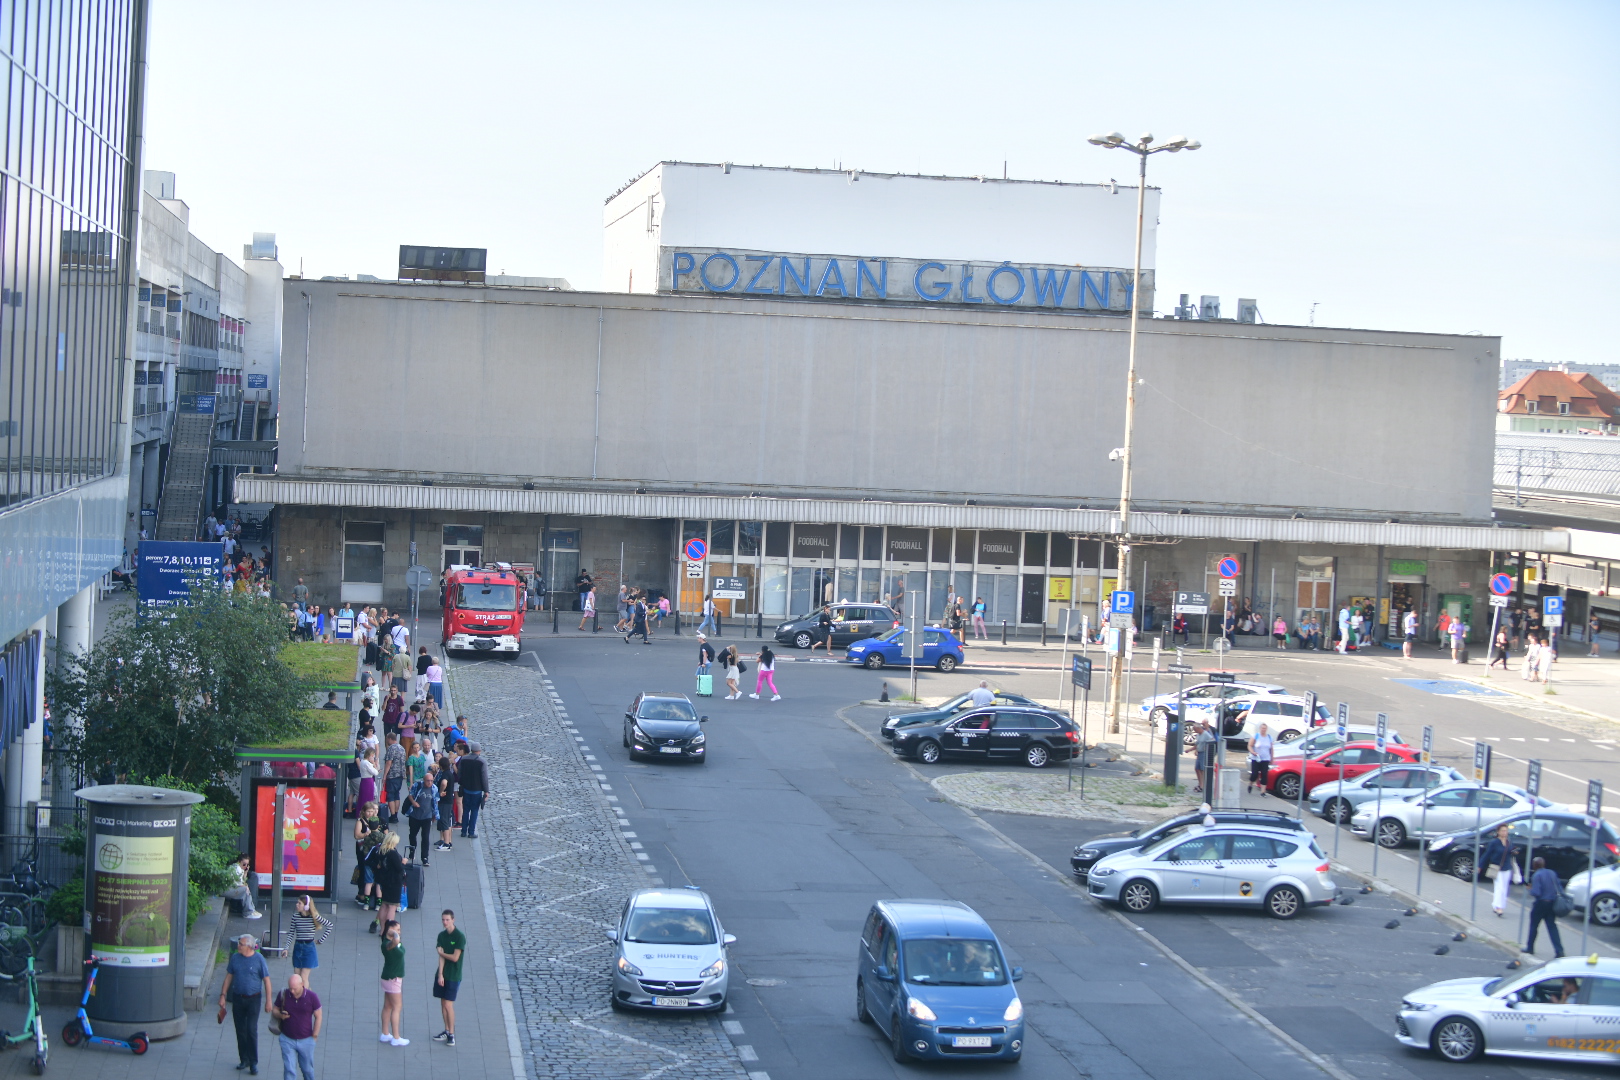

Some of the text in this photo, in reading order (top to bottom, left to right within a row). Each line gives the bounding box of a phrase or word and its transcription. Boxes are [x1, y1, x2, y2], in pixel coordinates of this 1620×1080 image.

[673, 252, 1146, 310] POZNAŃ GŁÓWNY
[798, 537, 829, 546] FOODHALL
[891, 541, 922, 550] FOODHALL
[983, 544, 1014, 553] FOODHALL
[116, 878, 150, 886] SIERPNIA
